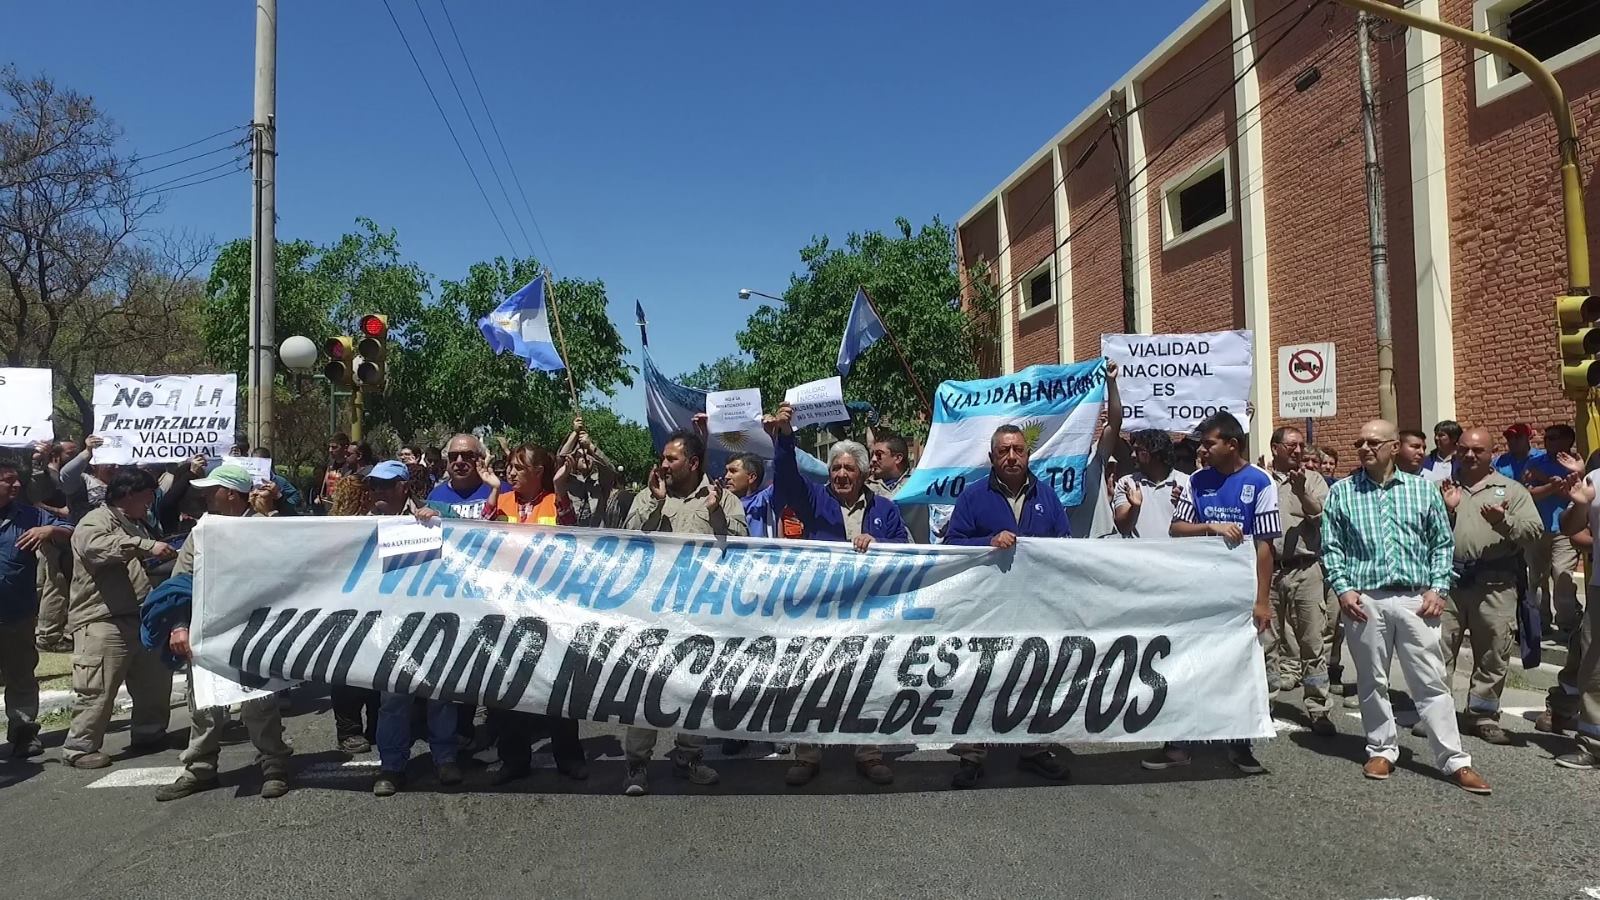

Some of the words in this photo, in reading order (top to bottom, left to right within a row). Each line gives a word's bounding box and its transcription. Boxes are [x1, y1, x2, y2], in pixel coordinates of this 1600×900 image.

[1128, 341, 1210, 357] VIALIDAD
[1122, 363, 1213, 378] NACIONAL
[166, 389, 182, 411] A
[194, 385, 223, 407] LA
[940, 381, 1032, 413] VIALIDAD
[1153, 383, 1175, 397] ES
[1122, 406, 1144, 418] DE
[0, 425, 32, 437] /17
[140, 431, 218, 444] VIALIDAD
[132, 445, 221, 458] NACIONAL
[926, 475, 965, 498] NO
[651, 540, 936, 621] NACIONAL
[229, 606, 548, 712] VIALIDAD
[897, 635, 964, 689] ES
[546, 621, 895, 735] NACIONAL
[952, 634, 1171, 735] TODOS
[878, 689, 953, 735] DE
